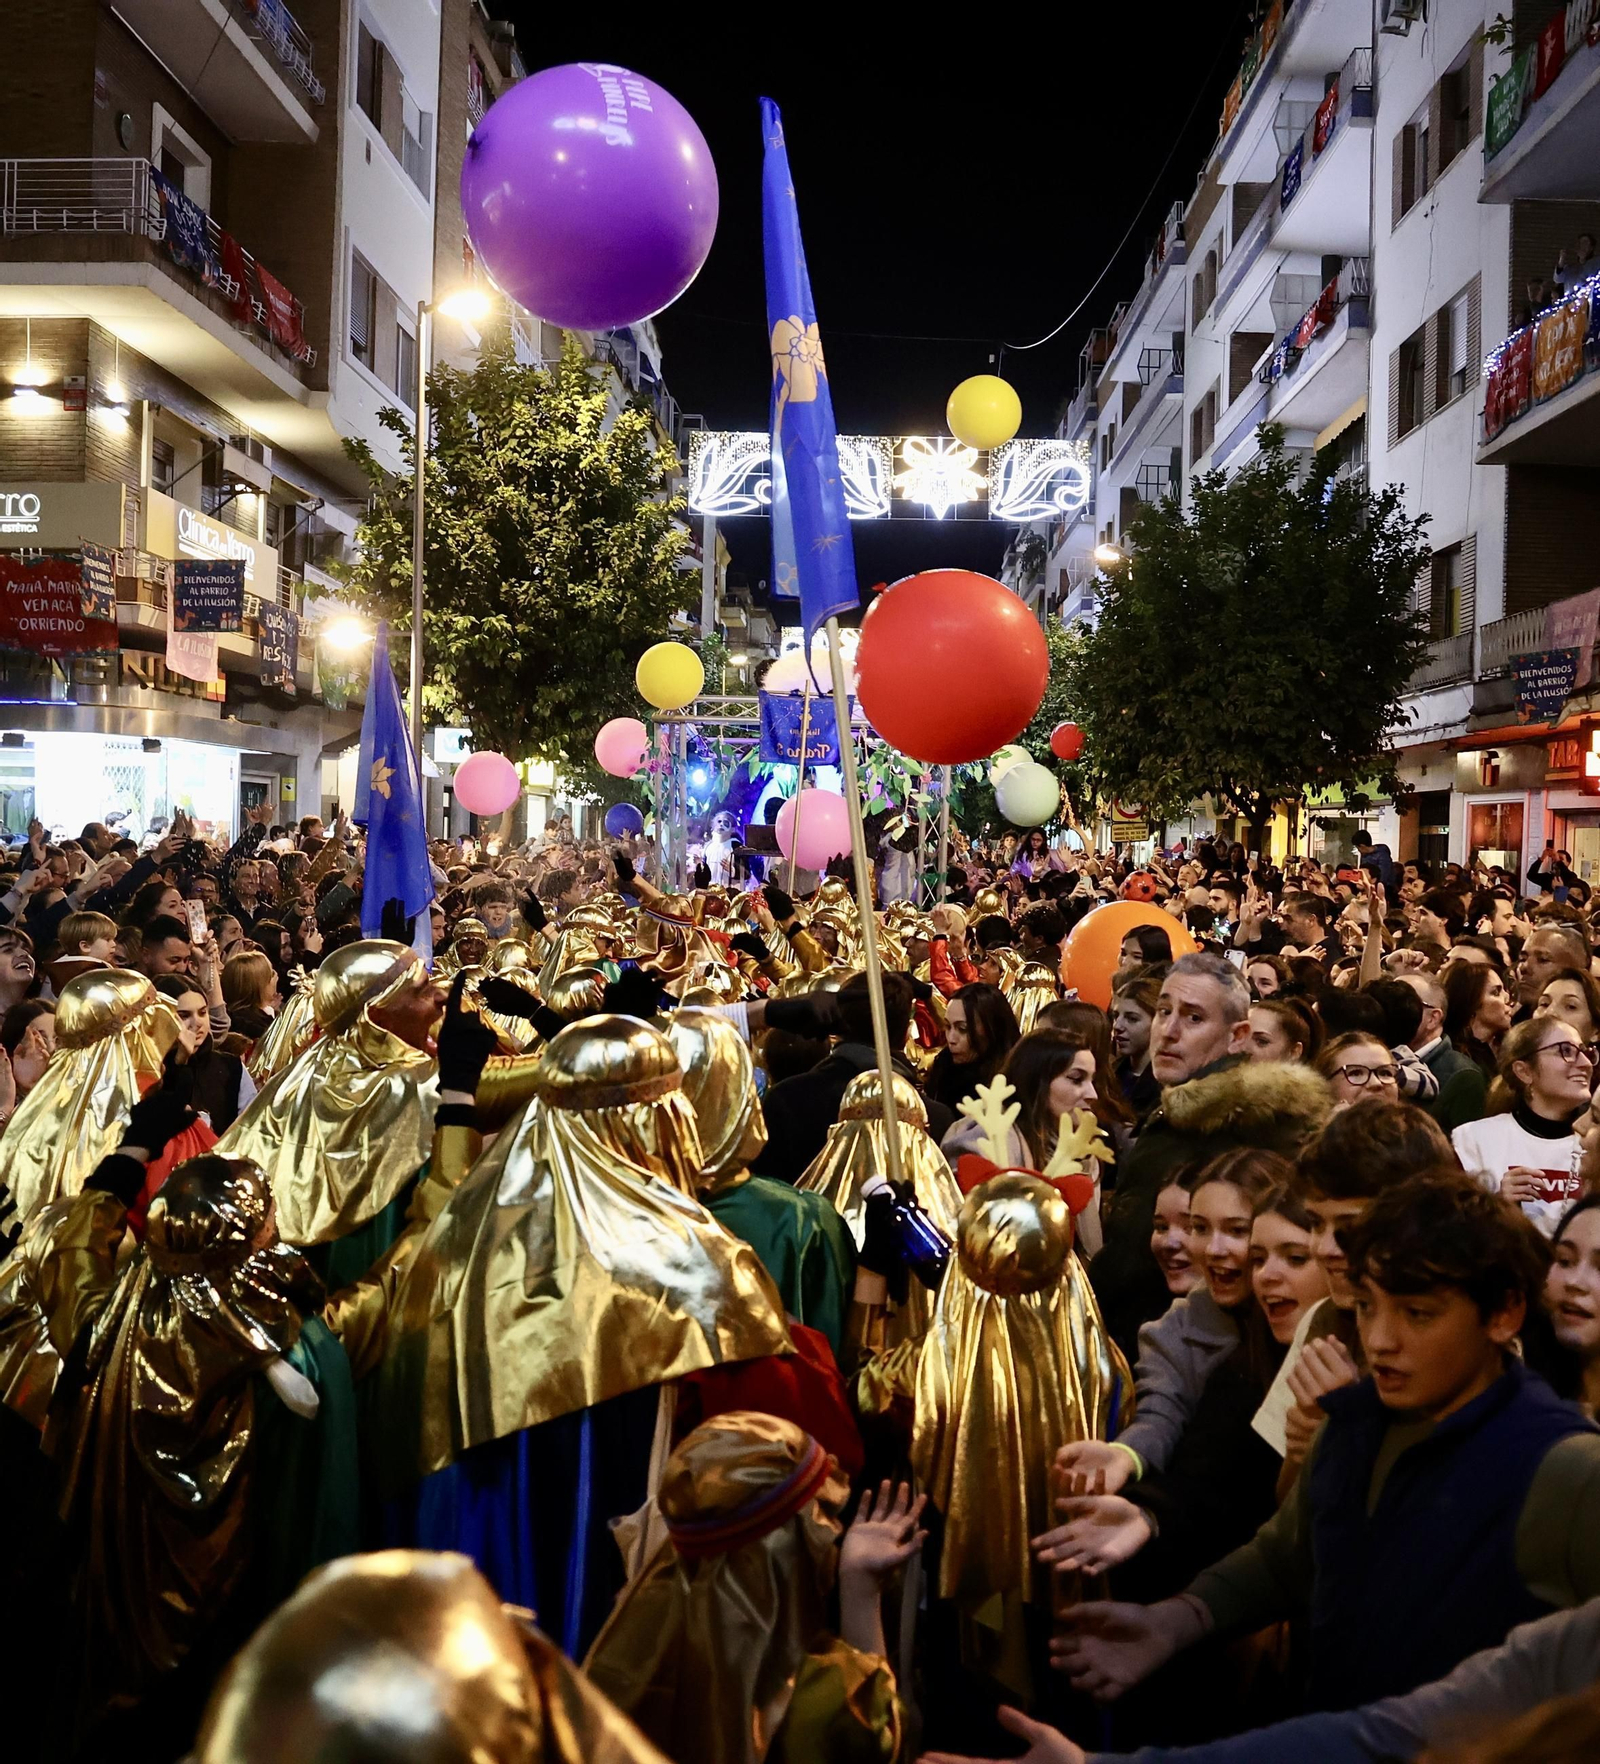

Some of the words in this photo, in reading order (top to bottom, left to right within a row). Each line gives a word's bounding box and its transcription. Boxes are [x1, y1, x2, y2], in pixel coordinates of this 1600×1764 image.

[178, 508, 219, 549] Clínica
[183, 575, 236, 585] BIENVENIDOS
[189, 587, 199, 596] AL
[200, 586, 229, 596] BARRIO
[182, 598, 193, 607] DE
[10, 616, 85, 632] ORRIENDO
[1520, 665, 1572, 678] BIENVENIDOS
[1527, 680, 1536, 688] AL
[1537, 676, 1567, 688] BARRIO
[1521, 692, 1532, 701] DE
[1532, 690, 1543, 699] LA
